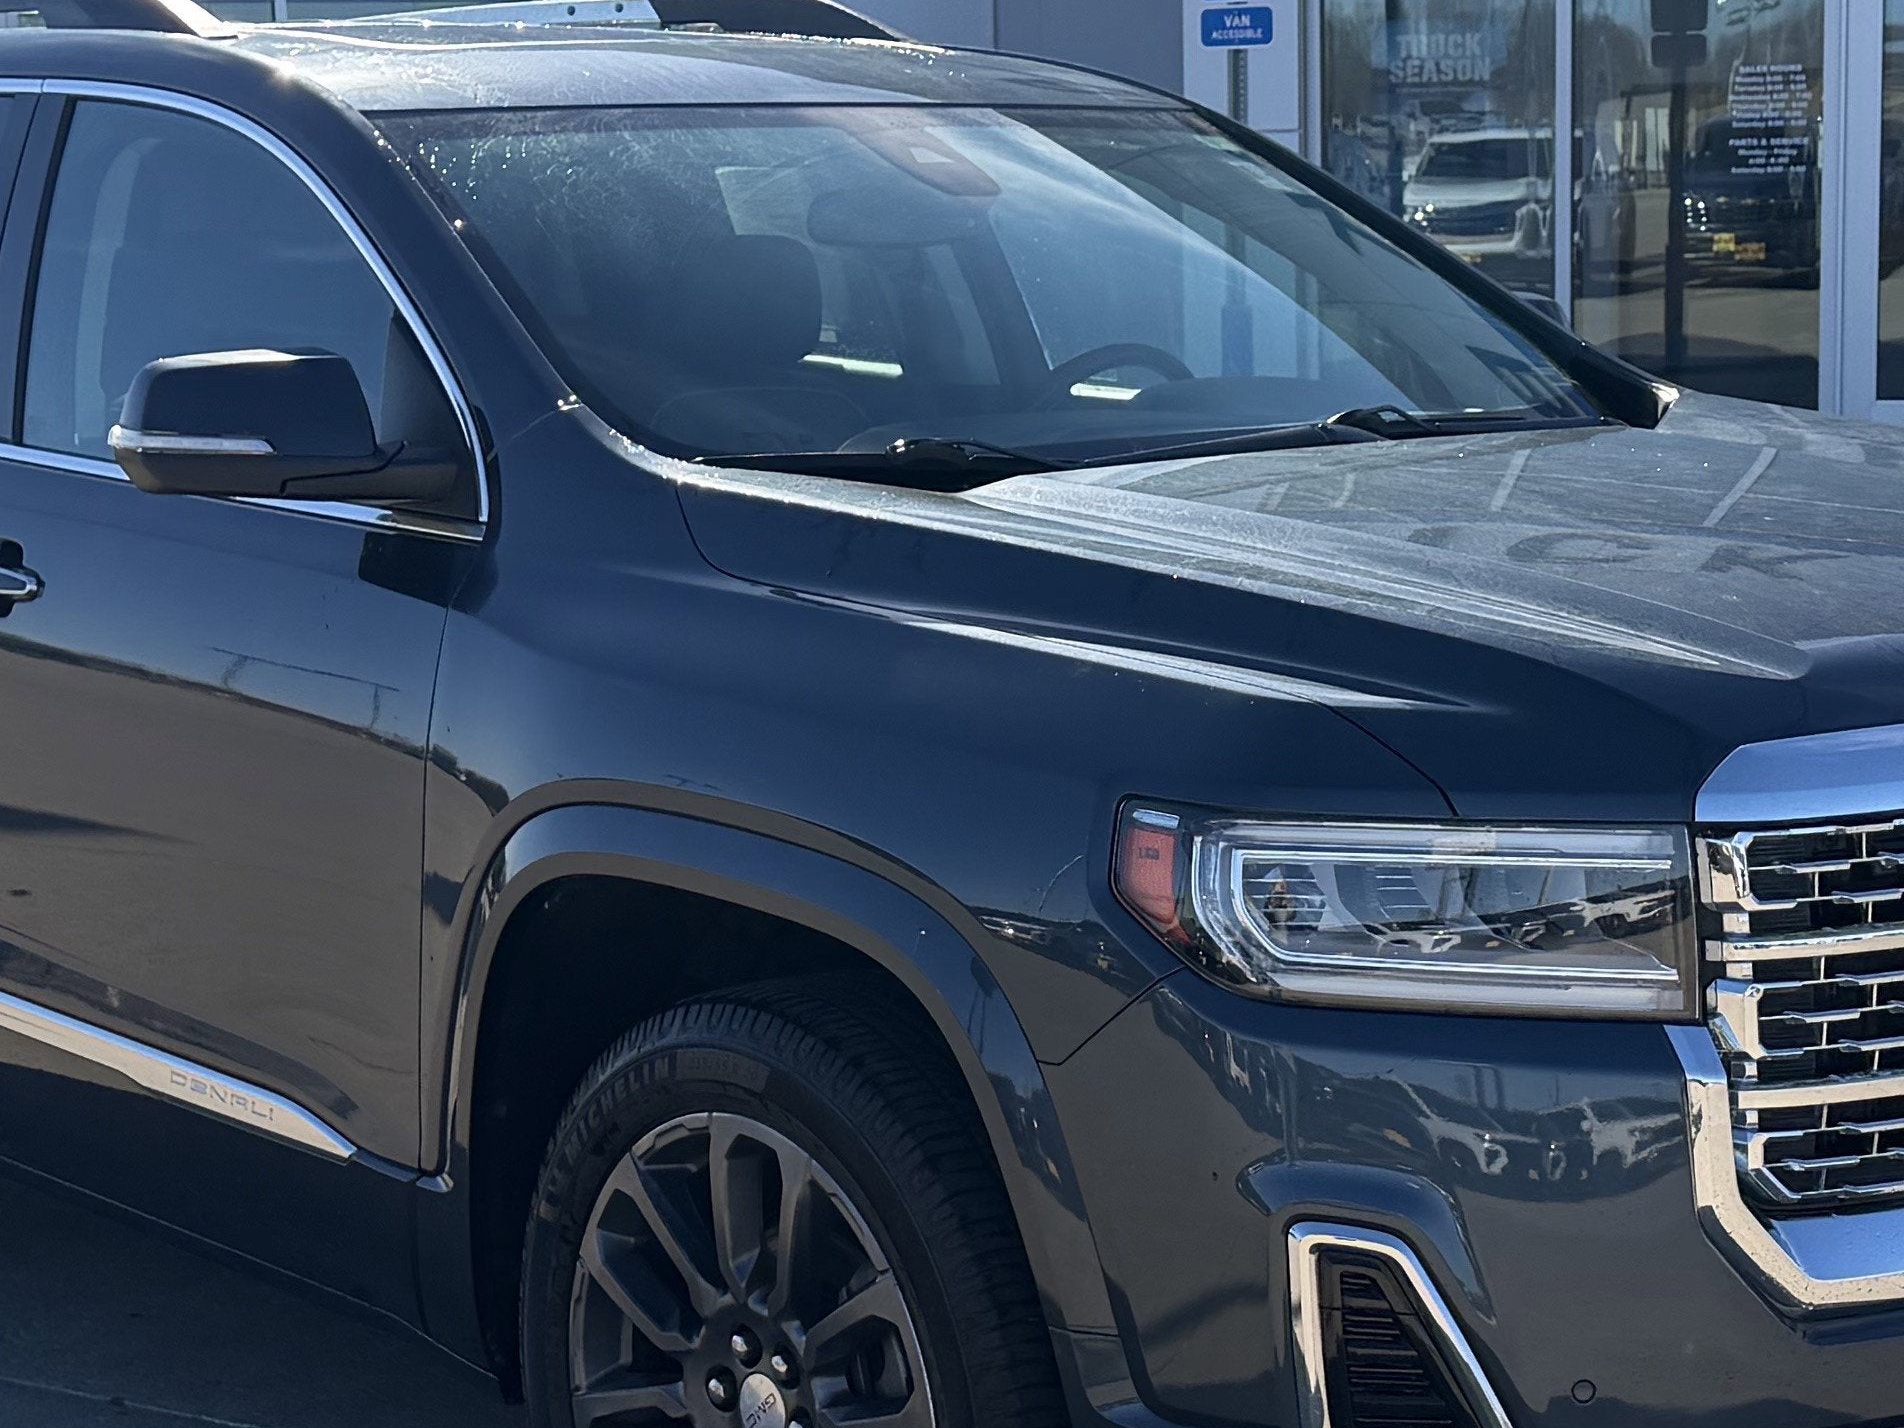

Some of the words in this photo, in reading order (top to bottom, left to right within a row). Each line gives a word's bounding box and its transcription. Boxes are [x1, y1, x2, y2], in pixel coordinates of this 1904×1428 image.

[1224, 14, 1250, 27] VAN
[1211, 29, 1264, 40] ACCESSIBLE
[1389, 57, 1491, 83] SEASON
[170, 1070, 274, 1121] DENALI
